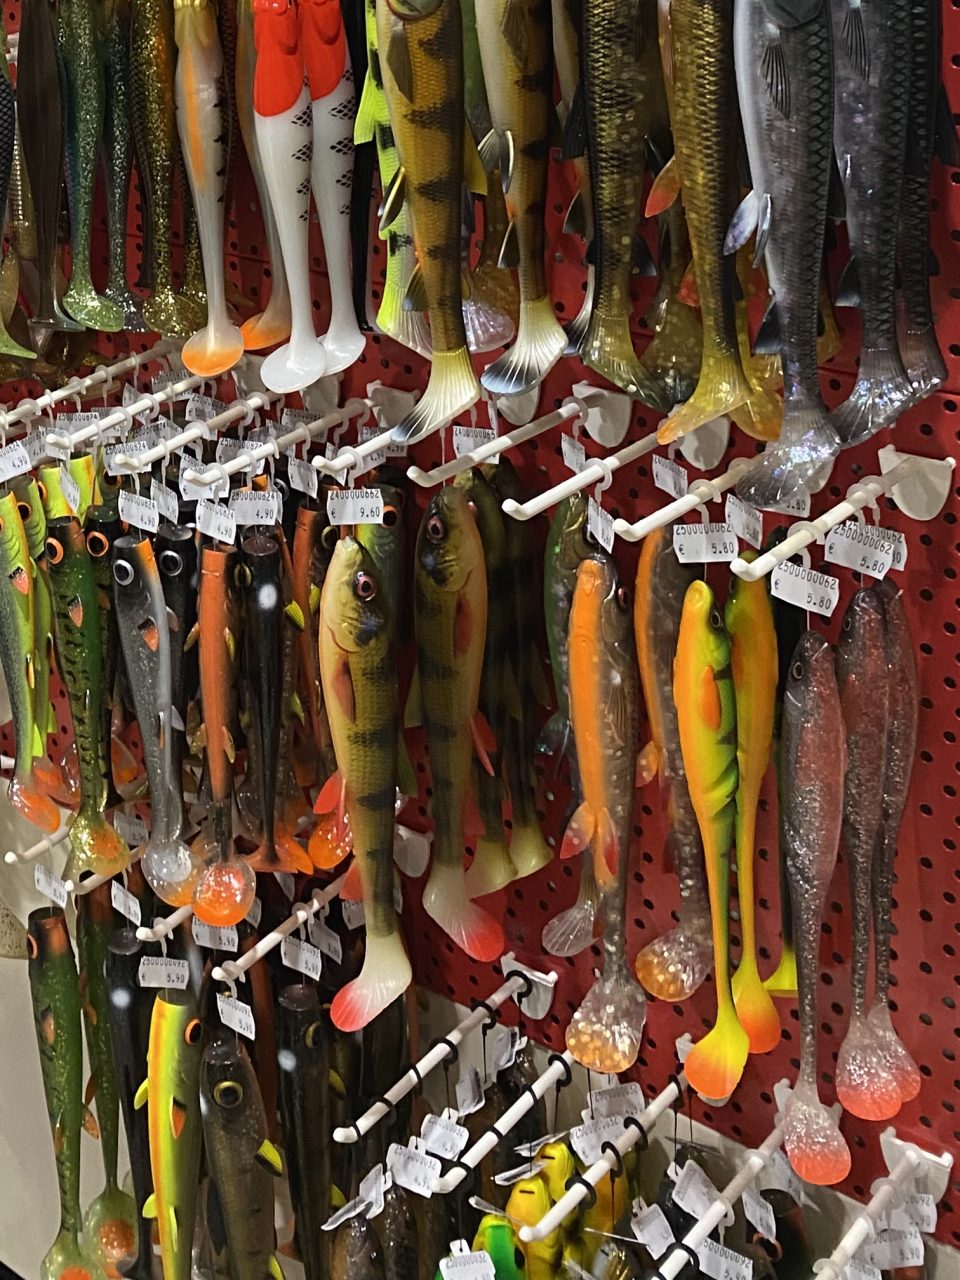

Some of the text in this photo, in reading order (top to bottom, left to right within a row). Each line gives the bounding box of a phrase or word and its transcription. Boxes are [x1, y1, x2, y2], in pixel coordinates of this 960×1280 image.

[256, 509, 274, 519] 4.90
[360, 508, 380, 518] 9.60
[834, 526, 892, 555] 2500000062
[712, 542, 735, 554] 5.80
[860, 556, 885, 573] 5.80
[778, 562, 837, 590] 2500000062
[806, 593, 832, 610] 5.80
[167, 972, 185, 983] 5.90
